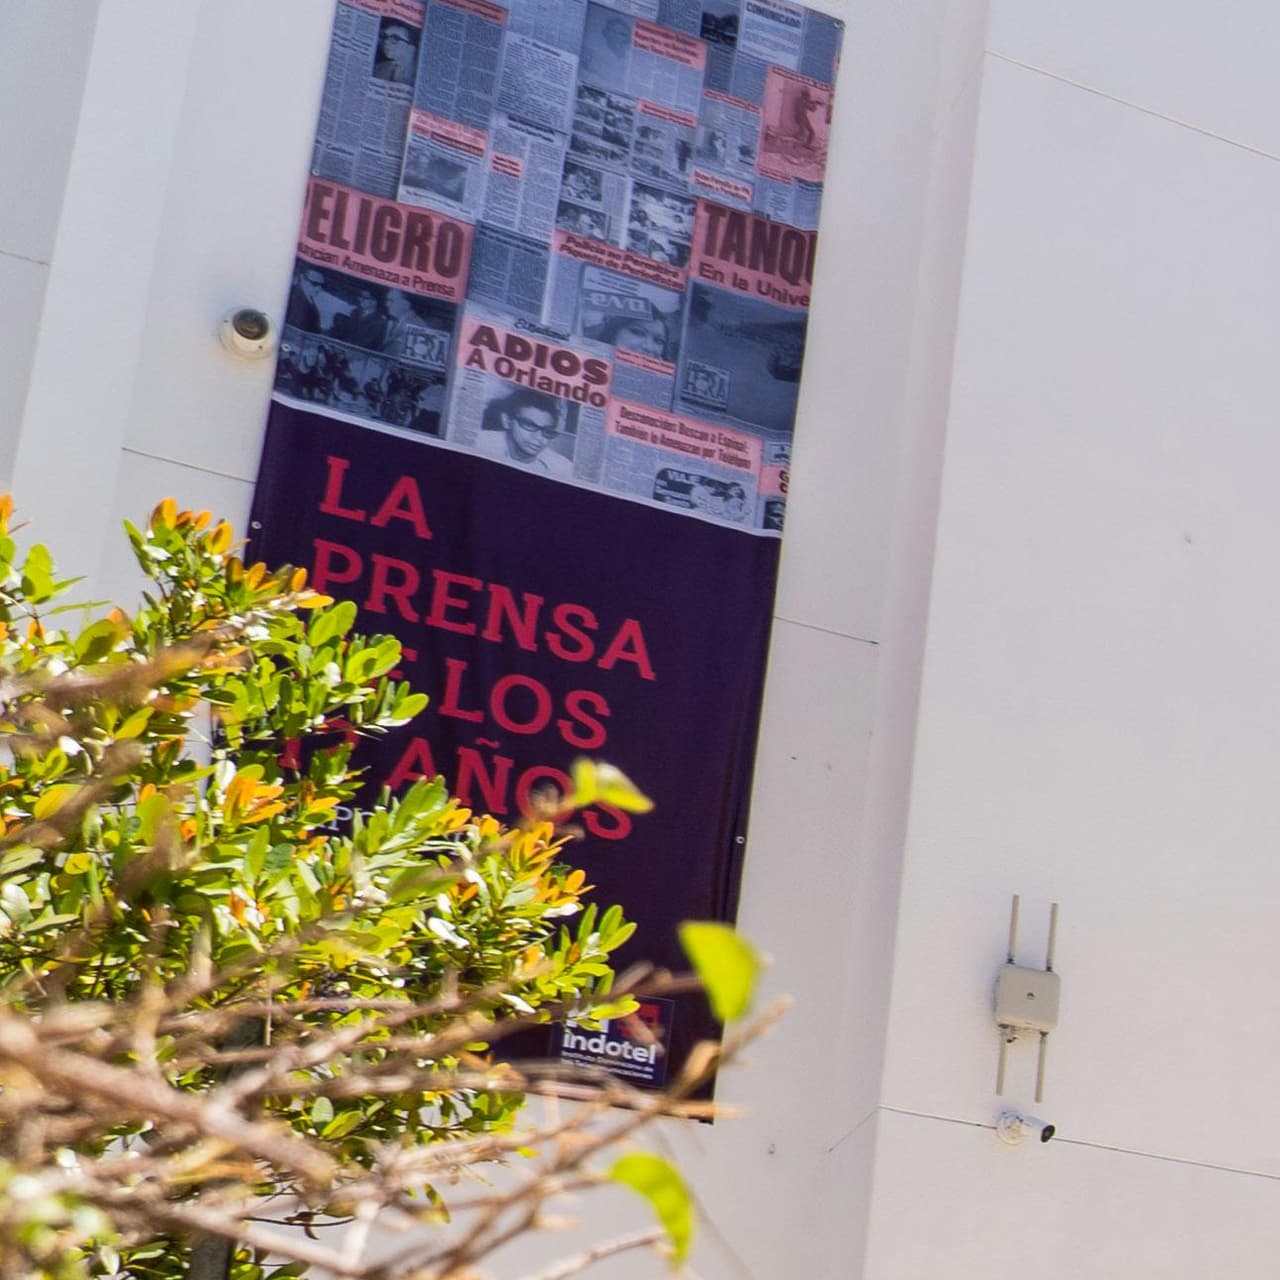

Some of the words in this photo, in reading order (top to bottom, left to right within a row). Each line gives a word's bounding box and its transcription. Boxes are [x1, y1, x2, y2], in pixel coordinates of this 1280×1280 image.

[304, 179, 465, 280] ELIGRO
[412, 275, 456, 297] Prensa
[699, 262, 725, 284] En
[732, 271, 749, 292] la
[465, 348, 487, 371] A
[494, 355, 607, 409] Orlando
[469, 324, 610, 385] ADIOS
[319, 455, 433, 540] LA
[311, 541, 657, 681] PRENSA
[438, 659, 612, 750] LOS
[562, 1028, 656, 1065] indotel
